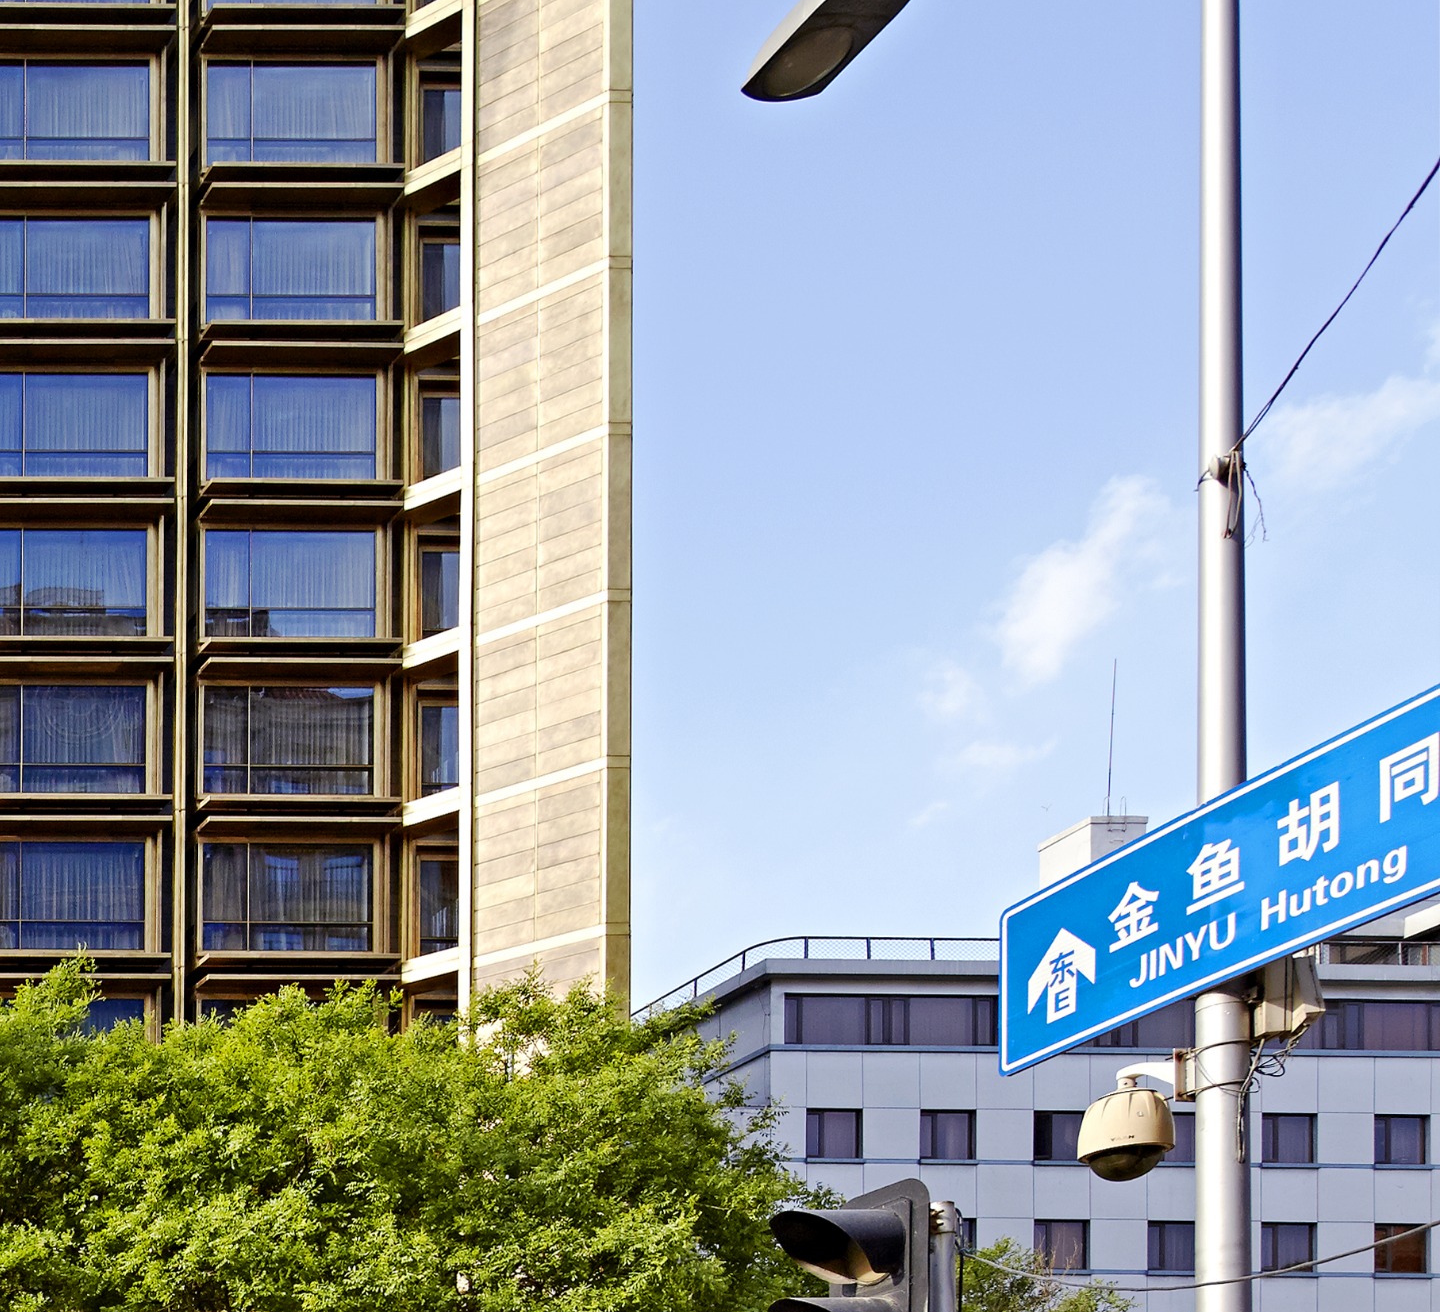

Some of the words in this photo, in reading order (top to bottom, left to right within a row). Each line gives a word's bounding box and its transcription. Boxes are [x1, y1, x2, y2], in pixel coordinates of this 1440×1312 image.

[1108, 732, 1440, 954] 金鱼胡同
[1129, 913, 1237, 989] JINYU
[1260, 845, 1408, 931] Hutong
[1049, 949, 1076, 985] 东
[1054, 990, 1070, 1012] E
